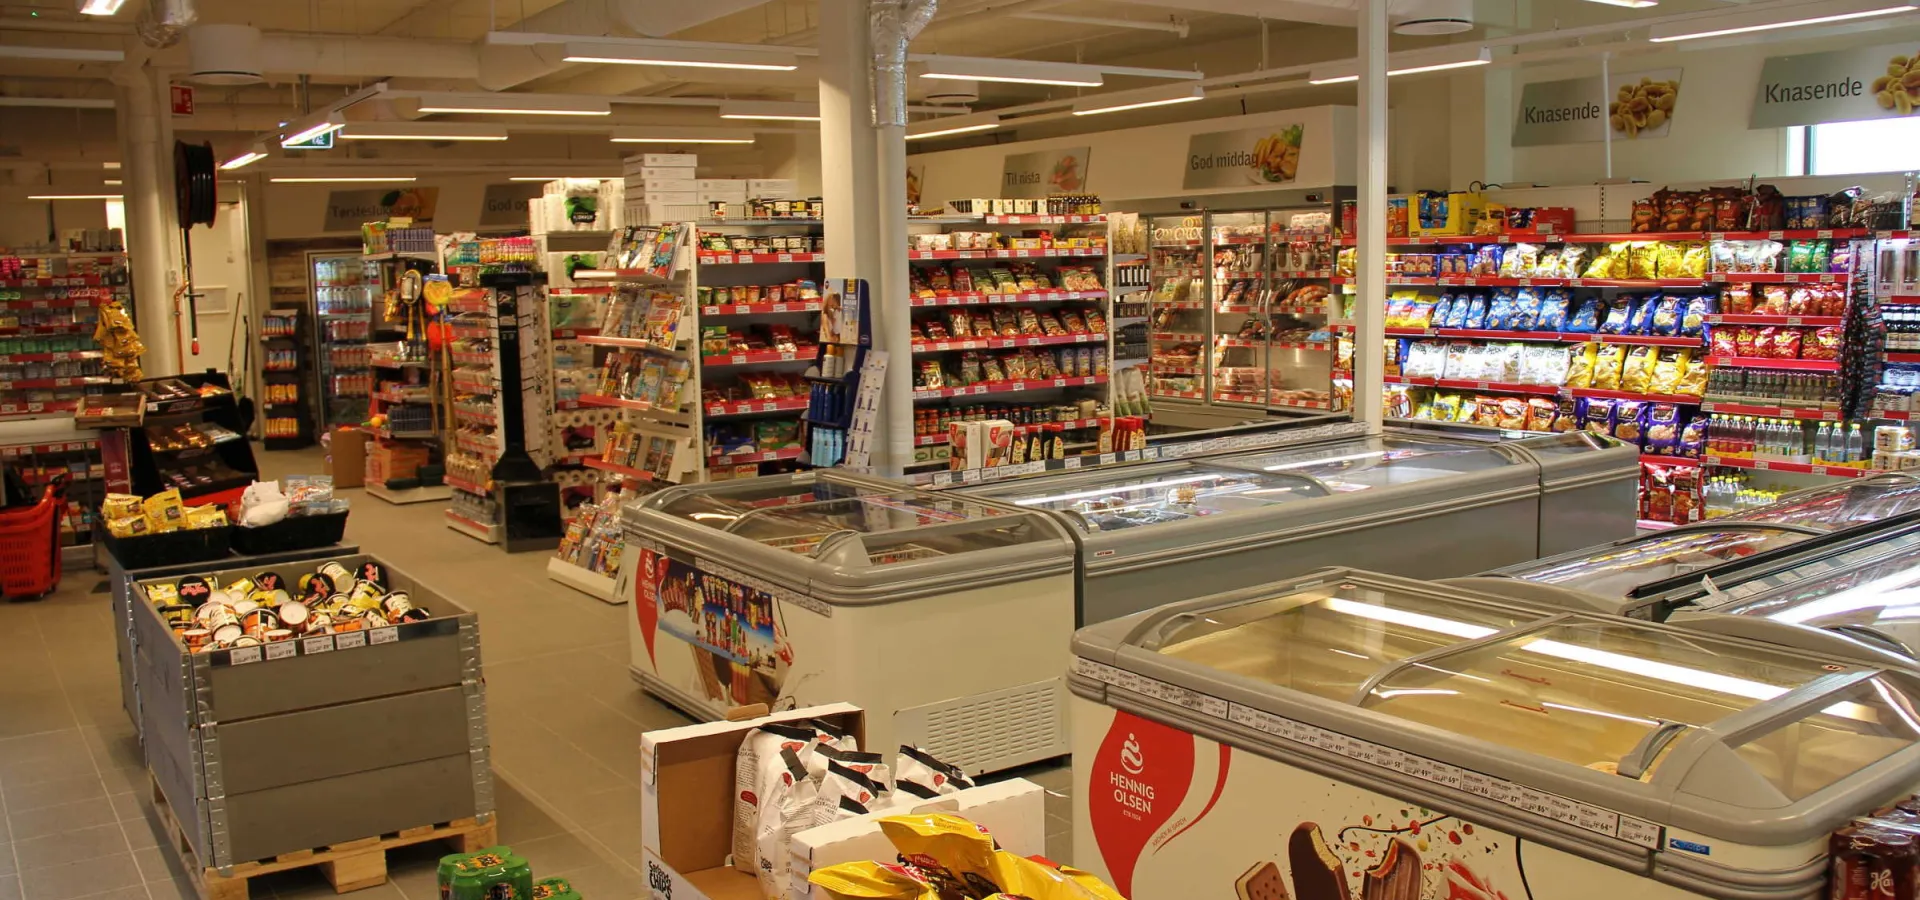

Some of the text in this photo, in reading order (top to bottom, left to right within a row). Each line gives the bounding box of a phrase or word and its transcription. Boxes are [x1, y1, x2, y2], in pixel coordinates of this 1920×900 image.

[1764, 76, 1863, 104] Knasende
[1524, 102, 1600, 125] Knasende
[1191, 149, 1259, 170] God middag
[1005, 172, 1017, 186] Til
[487, 198, 512, 212] God
[1110, 771, 1154, 799] HENNIG
[1113, 789, 1152, 815] OLSEN
